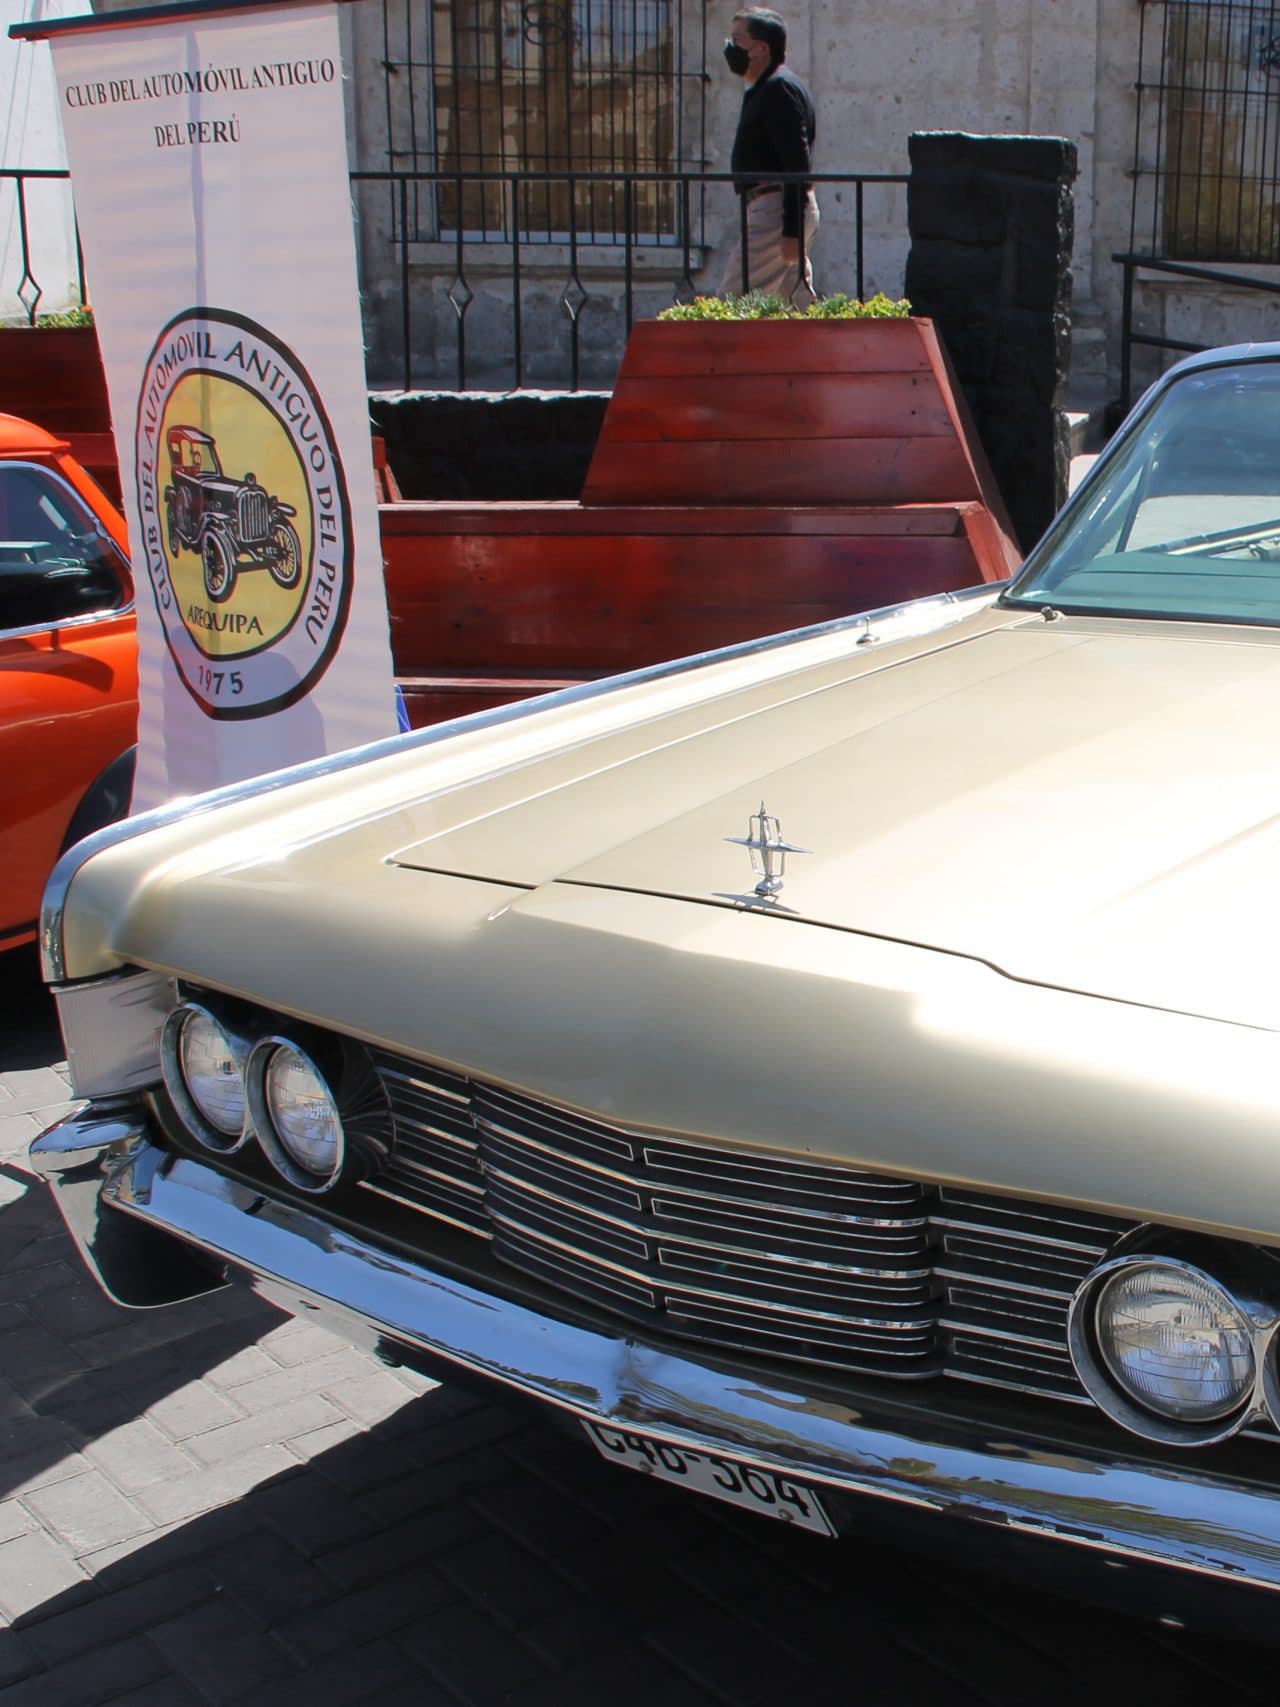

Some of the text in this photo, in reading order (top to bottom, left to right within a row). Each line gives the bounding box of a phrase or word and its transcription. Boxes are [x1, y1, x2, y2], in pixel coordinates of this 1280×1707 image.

[65, 58, 335, 108] CLUB DEL AUTOMÓVIL ANTIGUO
[154, 113, 241, 148] DEL PERÚ
[142, 331, 337, 645] CLUB DEL AUTOMOVIL ANTIGUO DEL PERU
[187, 604, 264, 636] AREQUIPA
[198, 665, 244, 695] 1975
